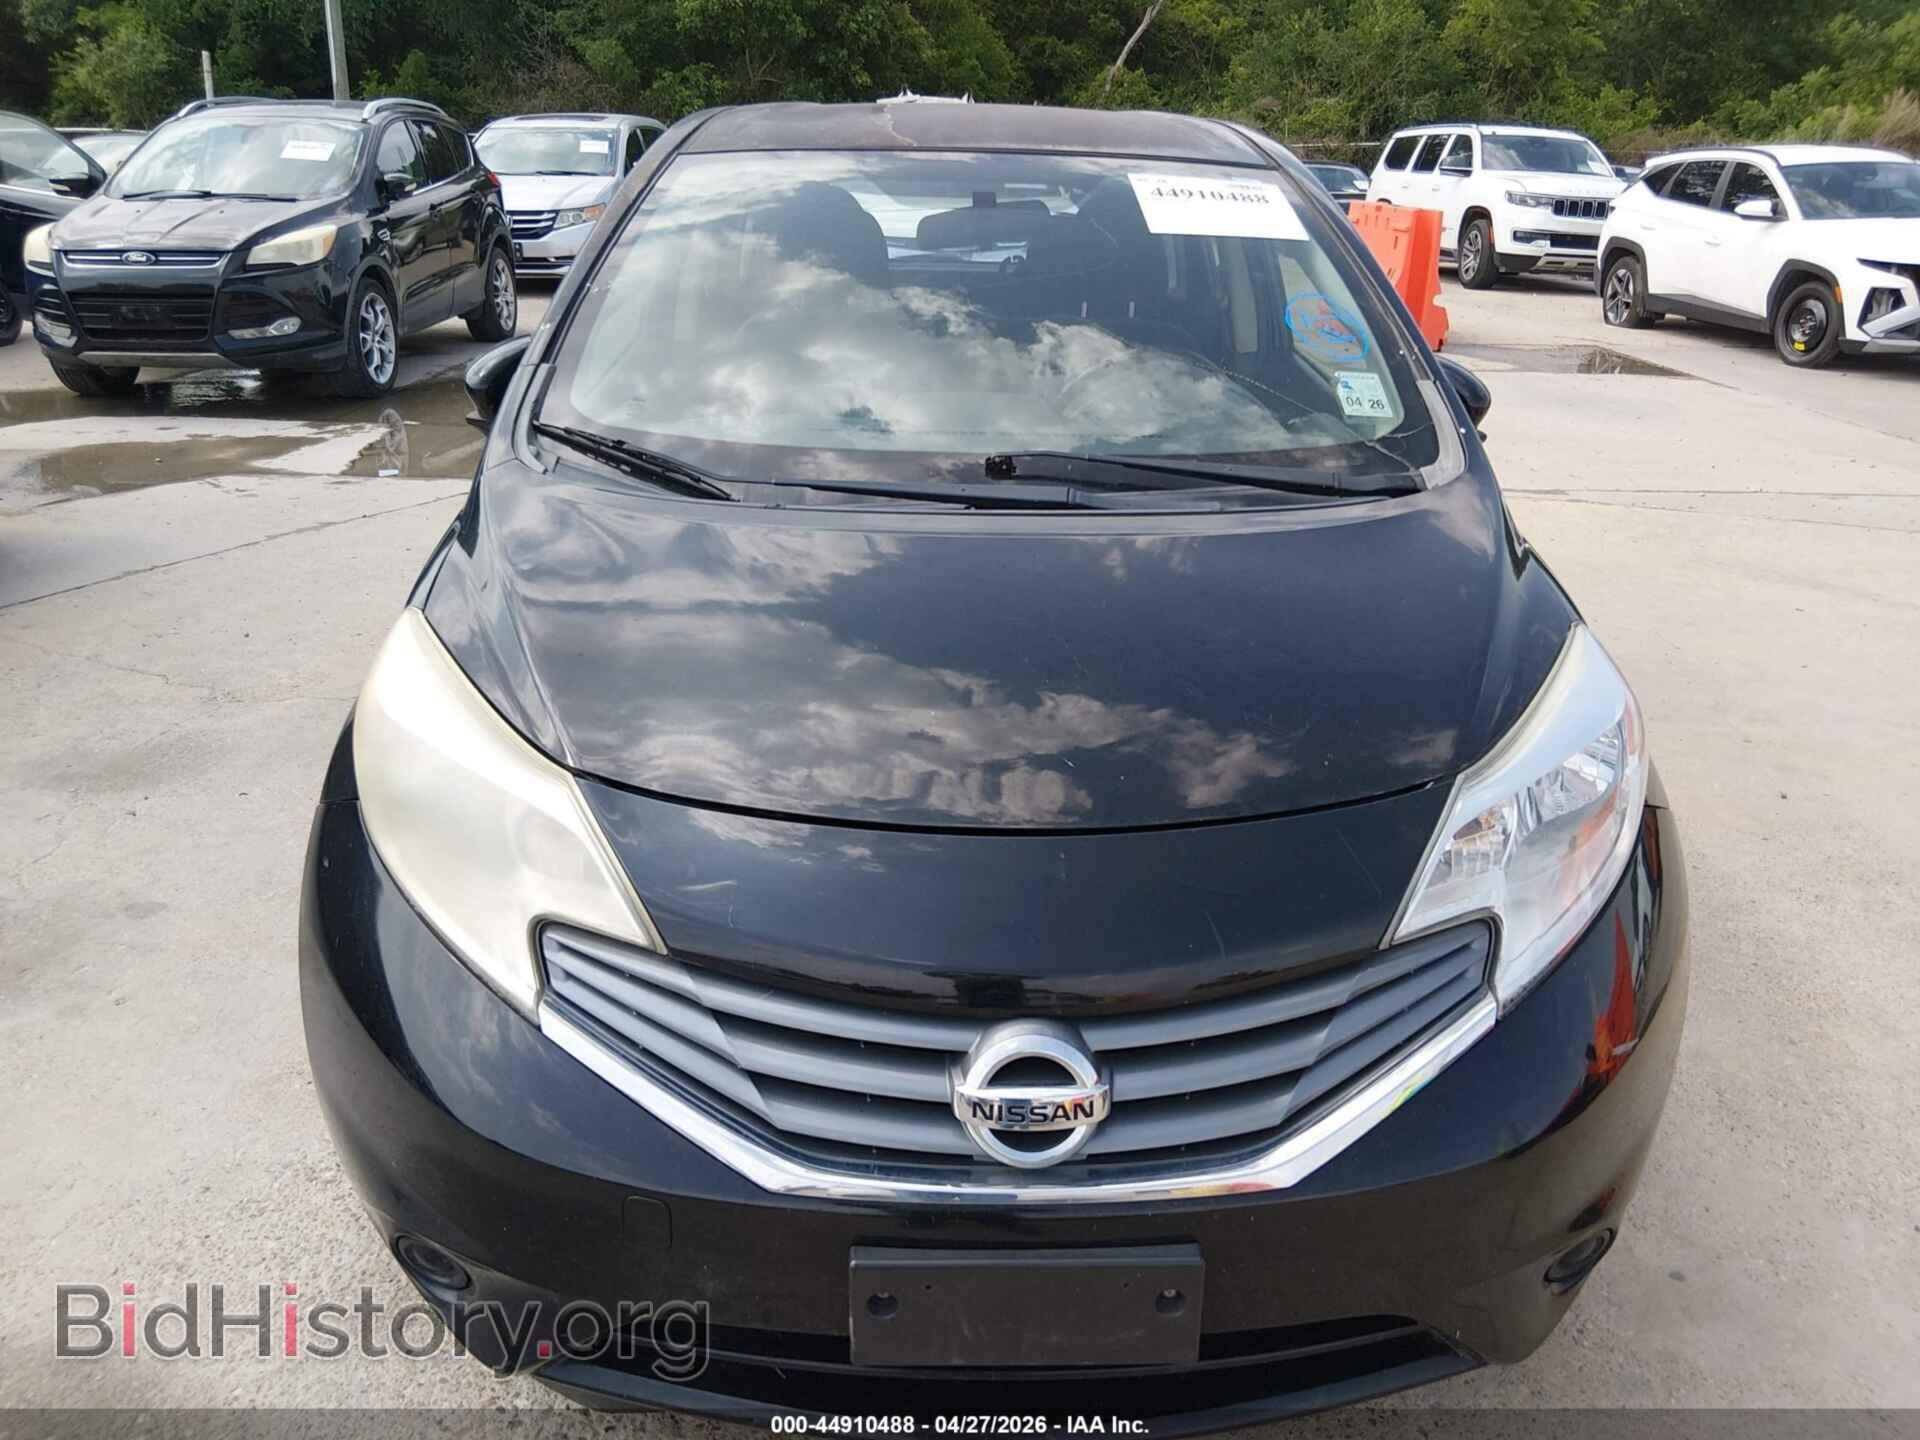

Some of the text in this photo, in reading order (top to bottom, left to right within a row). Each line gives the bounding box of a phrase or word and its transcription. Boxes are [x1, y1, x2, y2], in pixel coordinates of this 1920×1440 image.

[1151, 187, 1270, 204] 44910488
[1346, 397, 1385, 409] 04 26
[972, 1101, 1094, 1123] NISSAN
